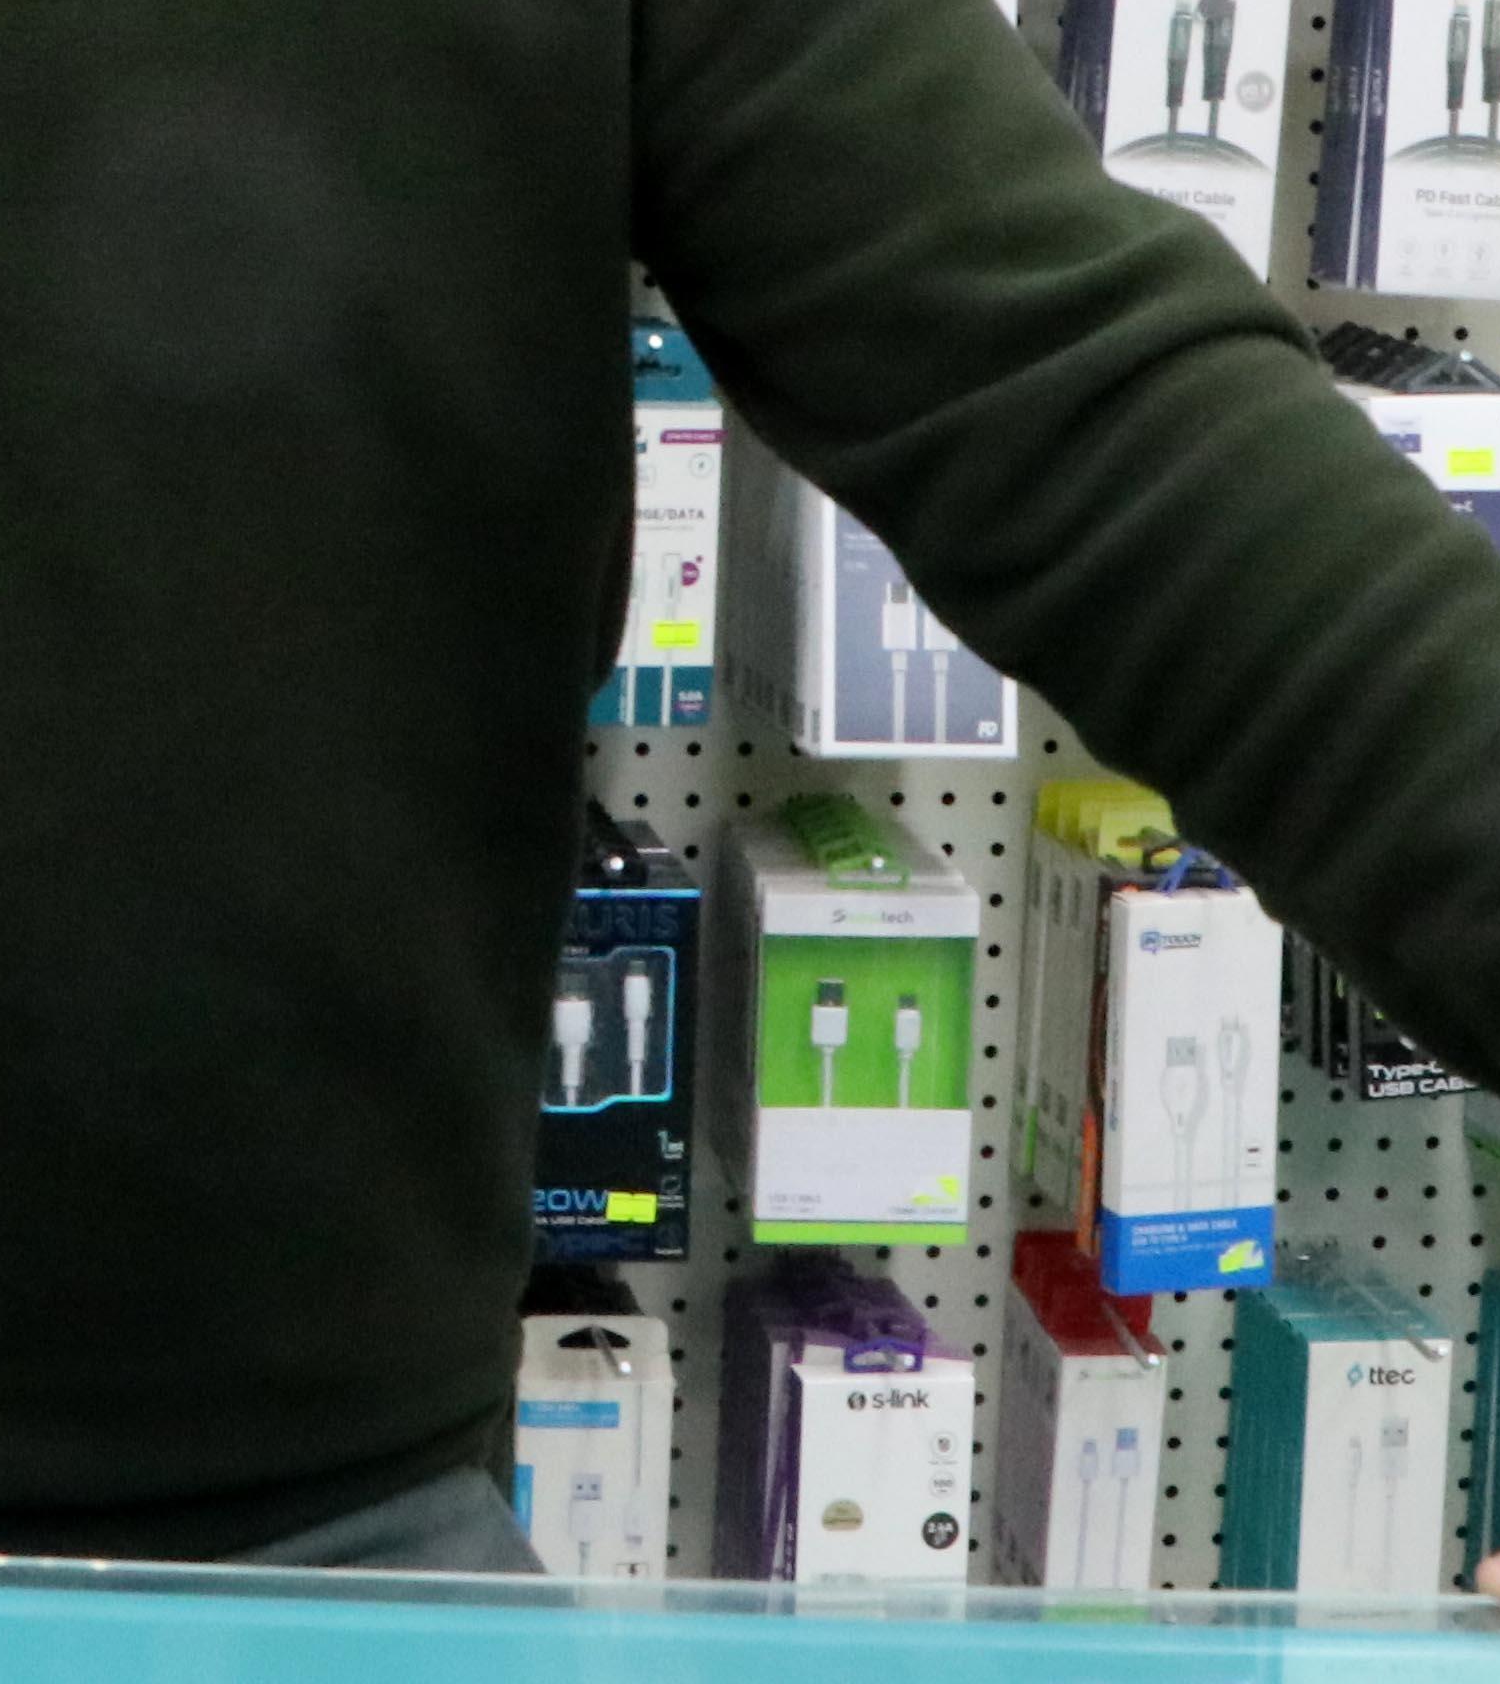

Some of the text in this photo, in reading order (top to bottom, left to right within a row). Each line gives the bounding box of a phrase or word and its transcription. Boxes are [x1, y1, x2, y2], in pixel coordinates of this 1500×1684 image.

[1368, 1080, 1415, 1098] USB
[1369, 1366, 1416, 1385] ttec
[871, 1389, 930, 1410] s-link
